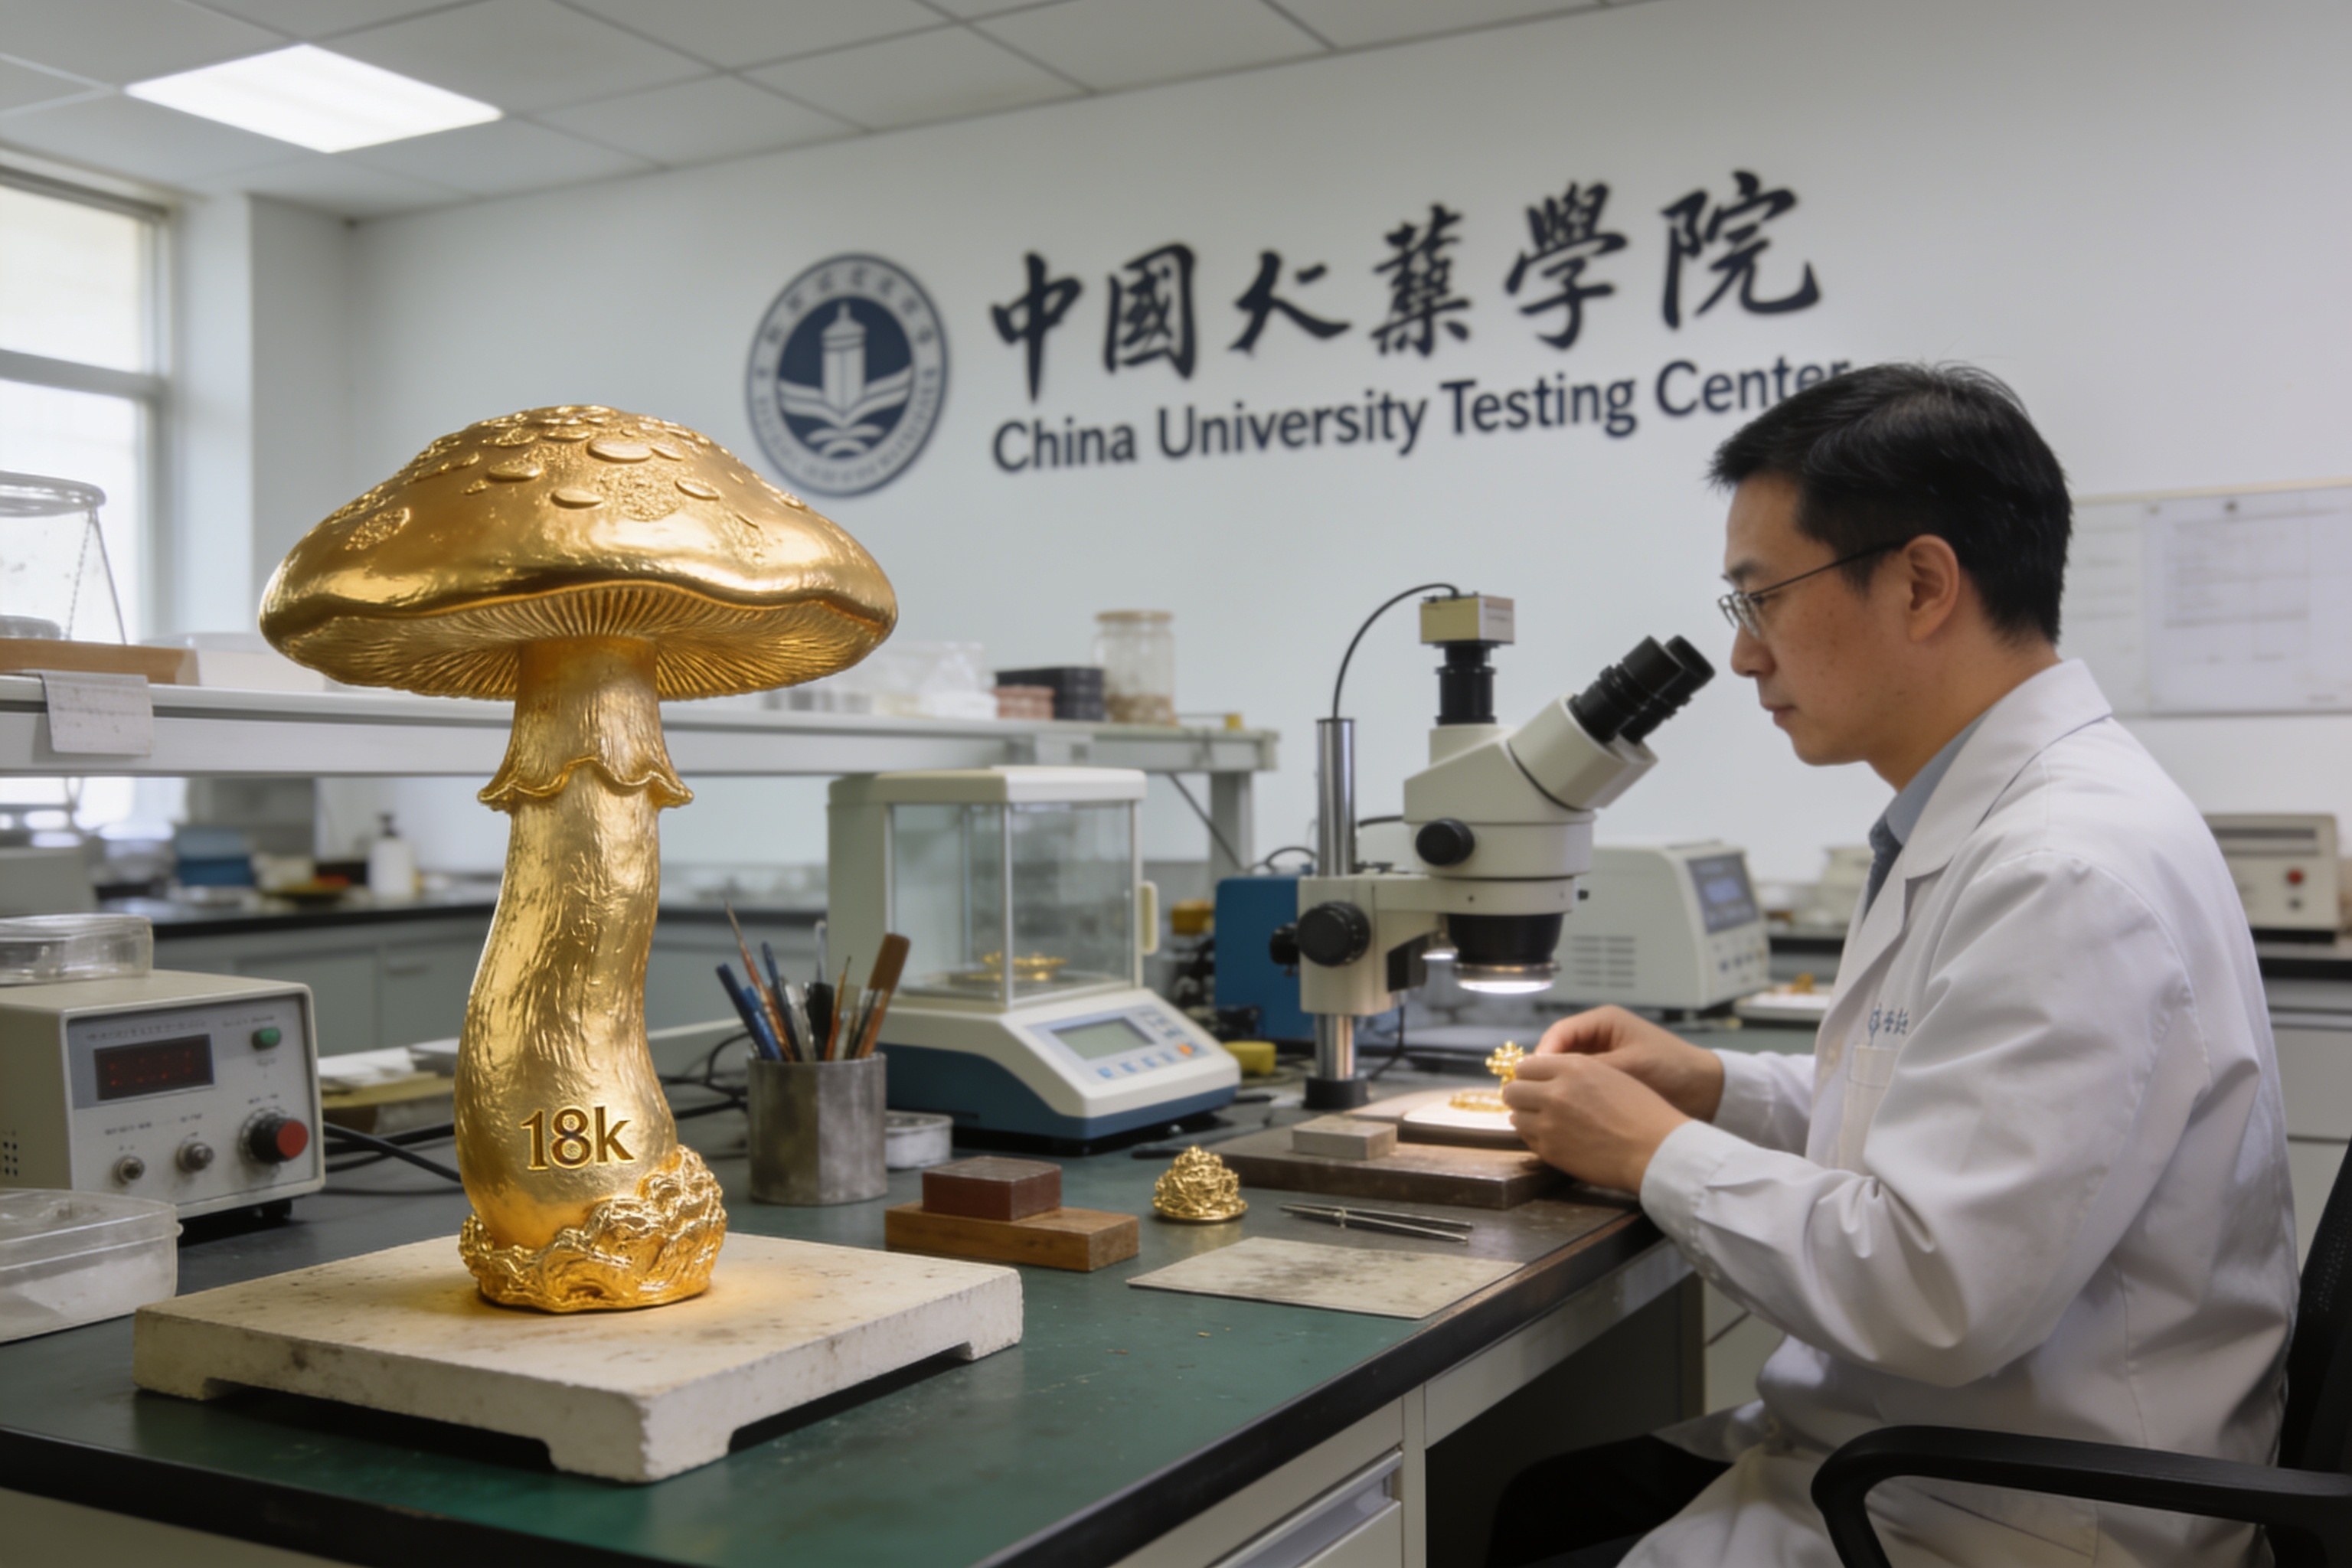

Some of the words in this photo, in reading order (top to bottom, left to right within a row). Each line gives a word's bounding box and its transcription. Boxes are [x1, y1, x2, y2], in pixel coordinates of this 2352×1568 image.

[992, 419, 1137, 472] China
[1158, 400, 1428, 457] University
[1439, 371, 1637, 439] Testing
[520, 1105, 637, 1170] 18k
